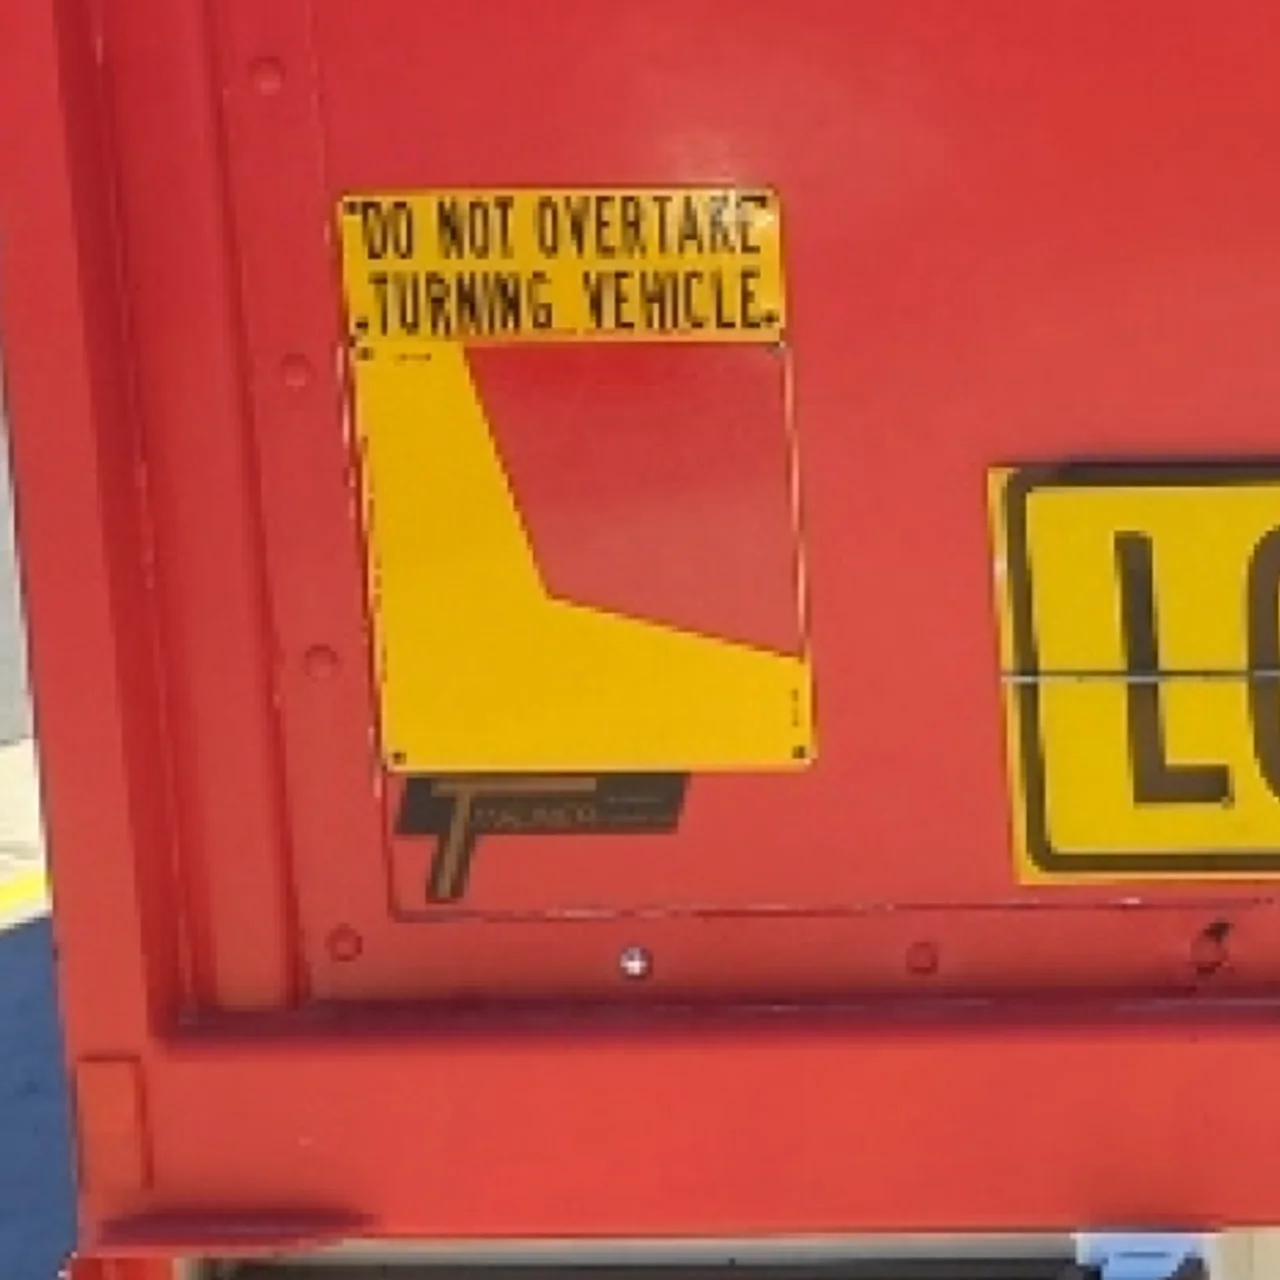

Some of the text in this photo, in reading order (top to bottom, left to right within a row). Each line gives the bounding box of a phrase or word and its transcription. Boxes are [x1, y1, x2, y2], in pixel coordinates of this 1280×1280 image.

[361, 195, 768, 260] DO NOT OVERTAKE
[369, 266, 763, 336] TURNING VEHICLE
